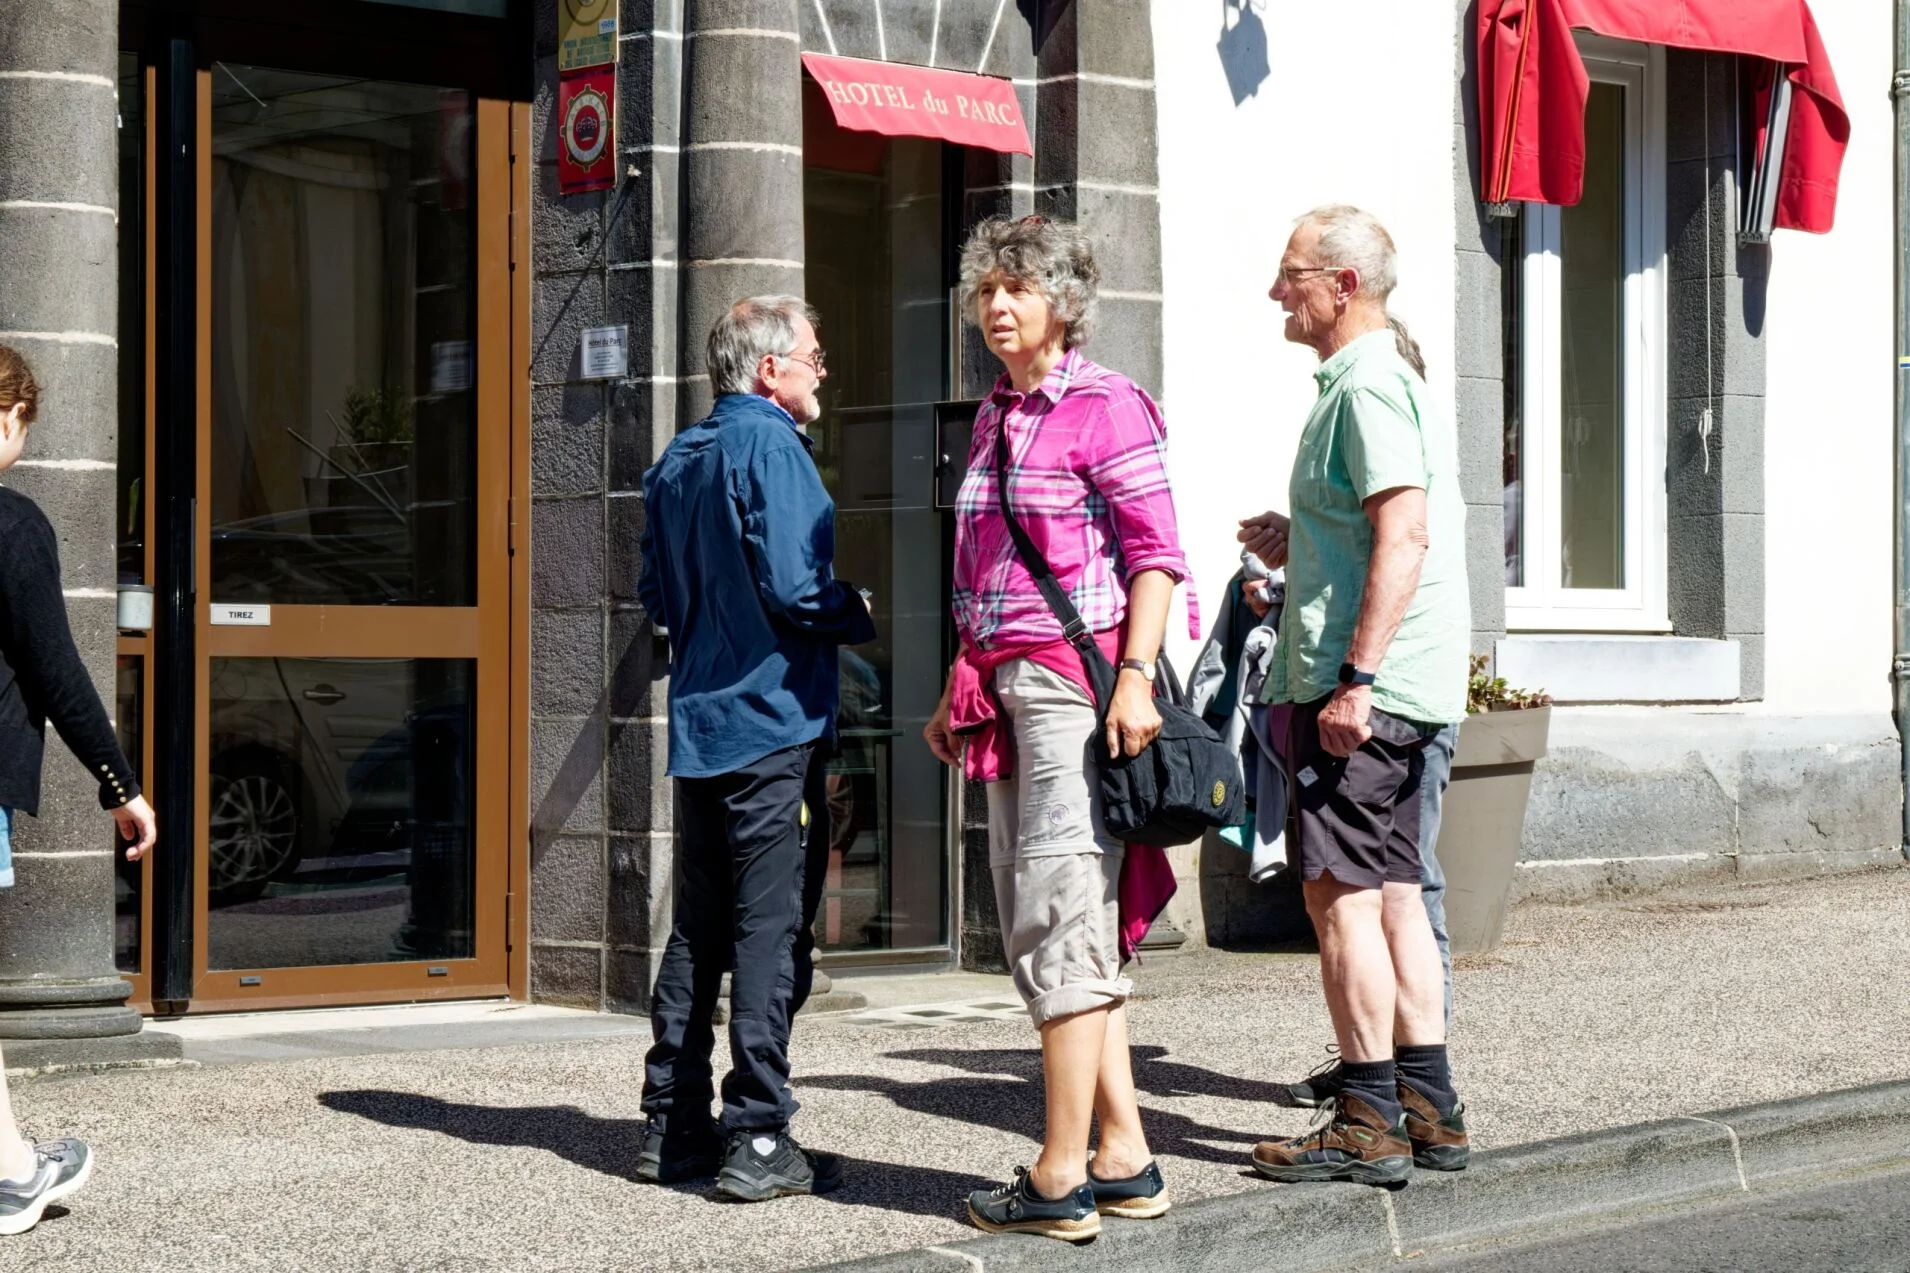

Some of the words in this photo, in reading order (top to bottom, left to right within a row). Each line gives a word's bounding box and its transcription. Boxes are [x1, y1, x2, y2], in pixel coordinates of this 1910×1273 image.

[826, 80, 915, 110] HOTEL
[923, 89, 949, 115] du
[955, 94, 1017, 126] PARC
[228, 611, 254, 619] TIREZ
